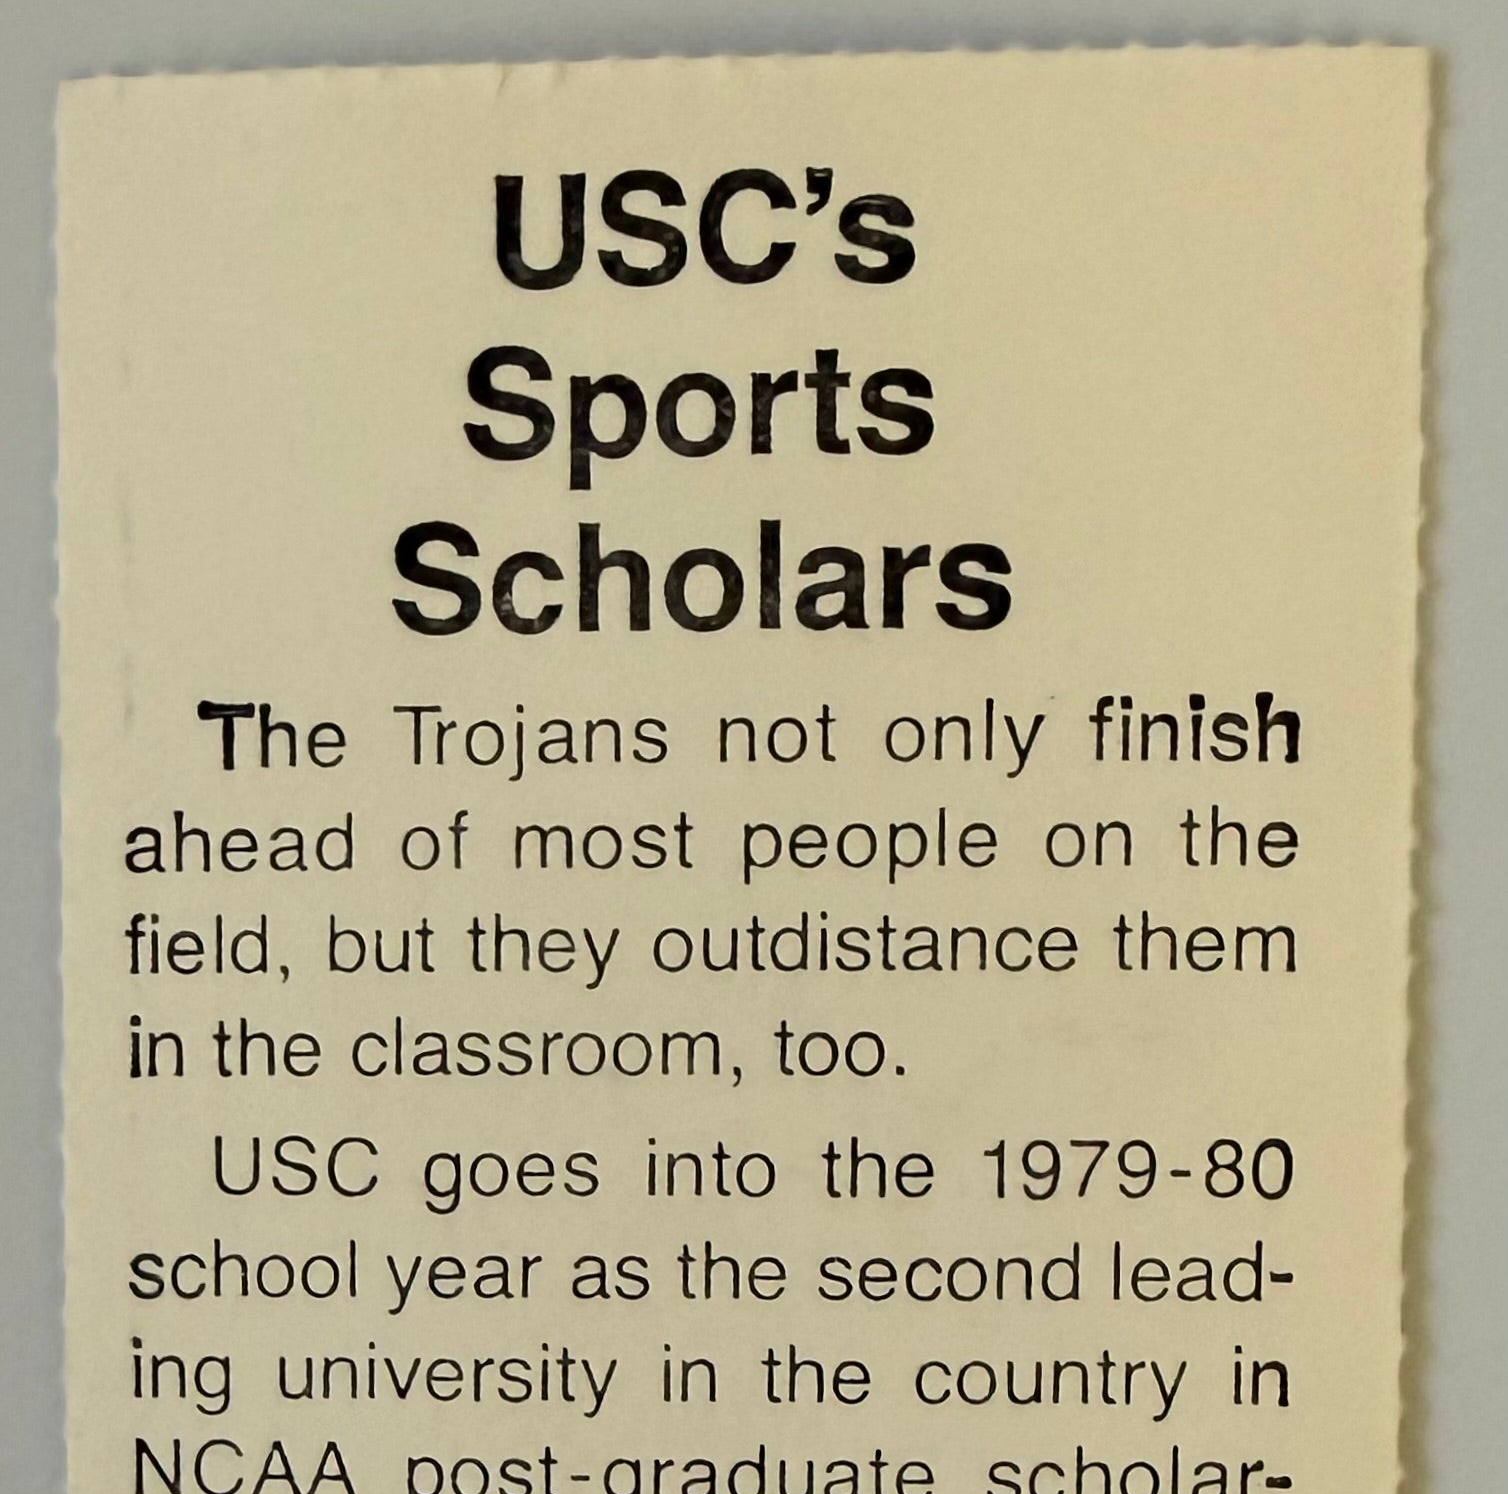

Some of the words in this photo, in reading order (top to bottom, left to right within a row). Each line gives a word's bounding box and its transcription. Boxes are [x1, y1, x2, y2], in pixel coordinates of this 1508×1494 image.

[493, 166, 916, 291] USC's
[462, 344, 935, 491] Sports
[391, 518, 1012, 637] Scholars
[196, 699, 347, 772] The
[392, 703, 668, 782] Trojans
[719, 703, 837, 764] not
[885, 697, 1046, 779] only
[1088, 691, 1301, 764] finish
[124, 810, 353, 874] ahead
[401, 809, 469, 871] of
[514, 811, 694, 870] most
[743, 806, 998, 886] people
[1045, 820, 1132, 868] on
[1179, 804, 1299, 869] the
[124, 912, 290, 984] field,
[328, 913, 435, 974] but
[466, 912, 620, 990] they
[653, 910, 1079, 973] outdistance
[1112, 909, 1297, 973] them
[129, 1014, 184, 1079] in
[212, 1017, 321, 1078] the
[351, 1015, 742, 1088] classroom,
[773, 1019, 906, 1078] too.
[214, 1135, 379, 1198] USC
[424, 1152, 599, 1216] goes
[647, 1137, 776, 1198] into
[820, 1135, 935, 1199] the
[983, 1137, 1294, 1201] 1979-80
[128, 1237, 357, 1300] school
[386, 1254, 543, 1316] year
[571, 1255, 650, 1301] as
[676, 1240, 787, 1301] the
[817, 1241, 1080, 1303] second
[1113, 1239, 1294, 1303] lead-
[131, 1335, 231, 1416] ing
[278, 1341, 618, 1419] university
[663, 1343, 717, 1403] in
[760, 1343, 871, 1405] the
[915, 1349, 1187, 1423] country
[1233, 1344, 1290, 1408] in
